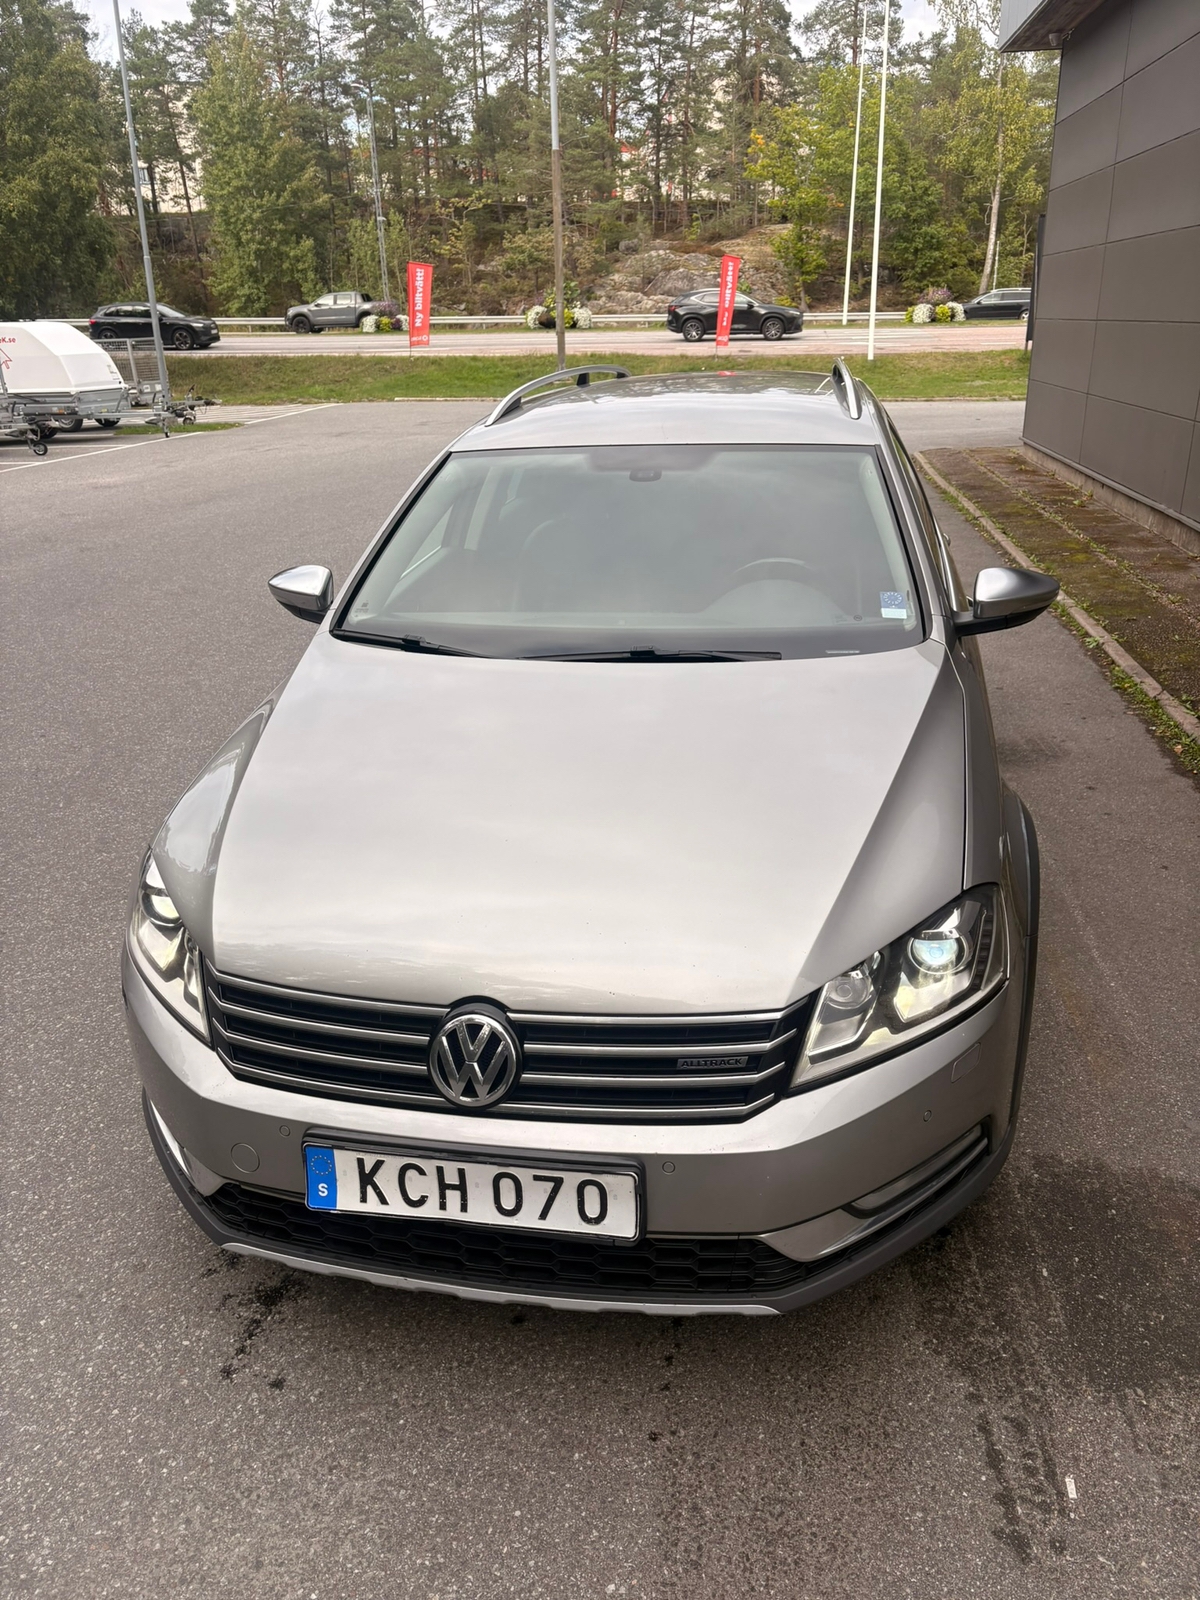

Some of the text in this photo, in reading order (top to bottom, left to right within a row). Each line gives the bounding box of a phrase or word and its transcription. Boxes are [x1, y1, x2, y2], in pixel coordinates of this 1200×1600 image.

[414, 268, 425, 310] biltvätt!
[414, 312, 424, 327] Ny
[0, 336, 16, 344] K.se
[681, 1058, 742, 1067] ALLTRACK
[318, 1183, 328, 1197] S
[356, 1156, 608, 1226] KCH 070
